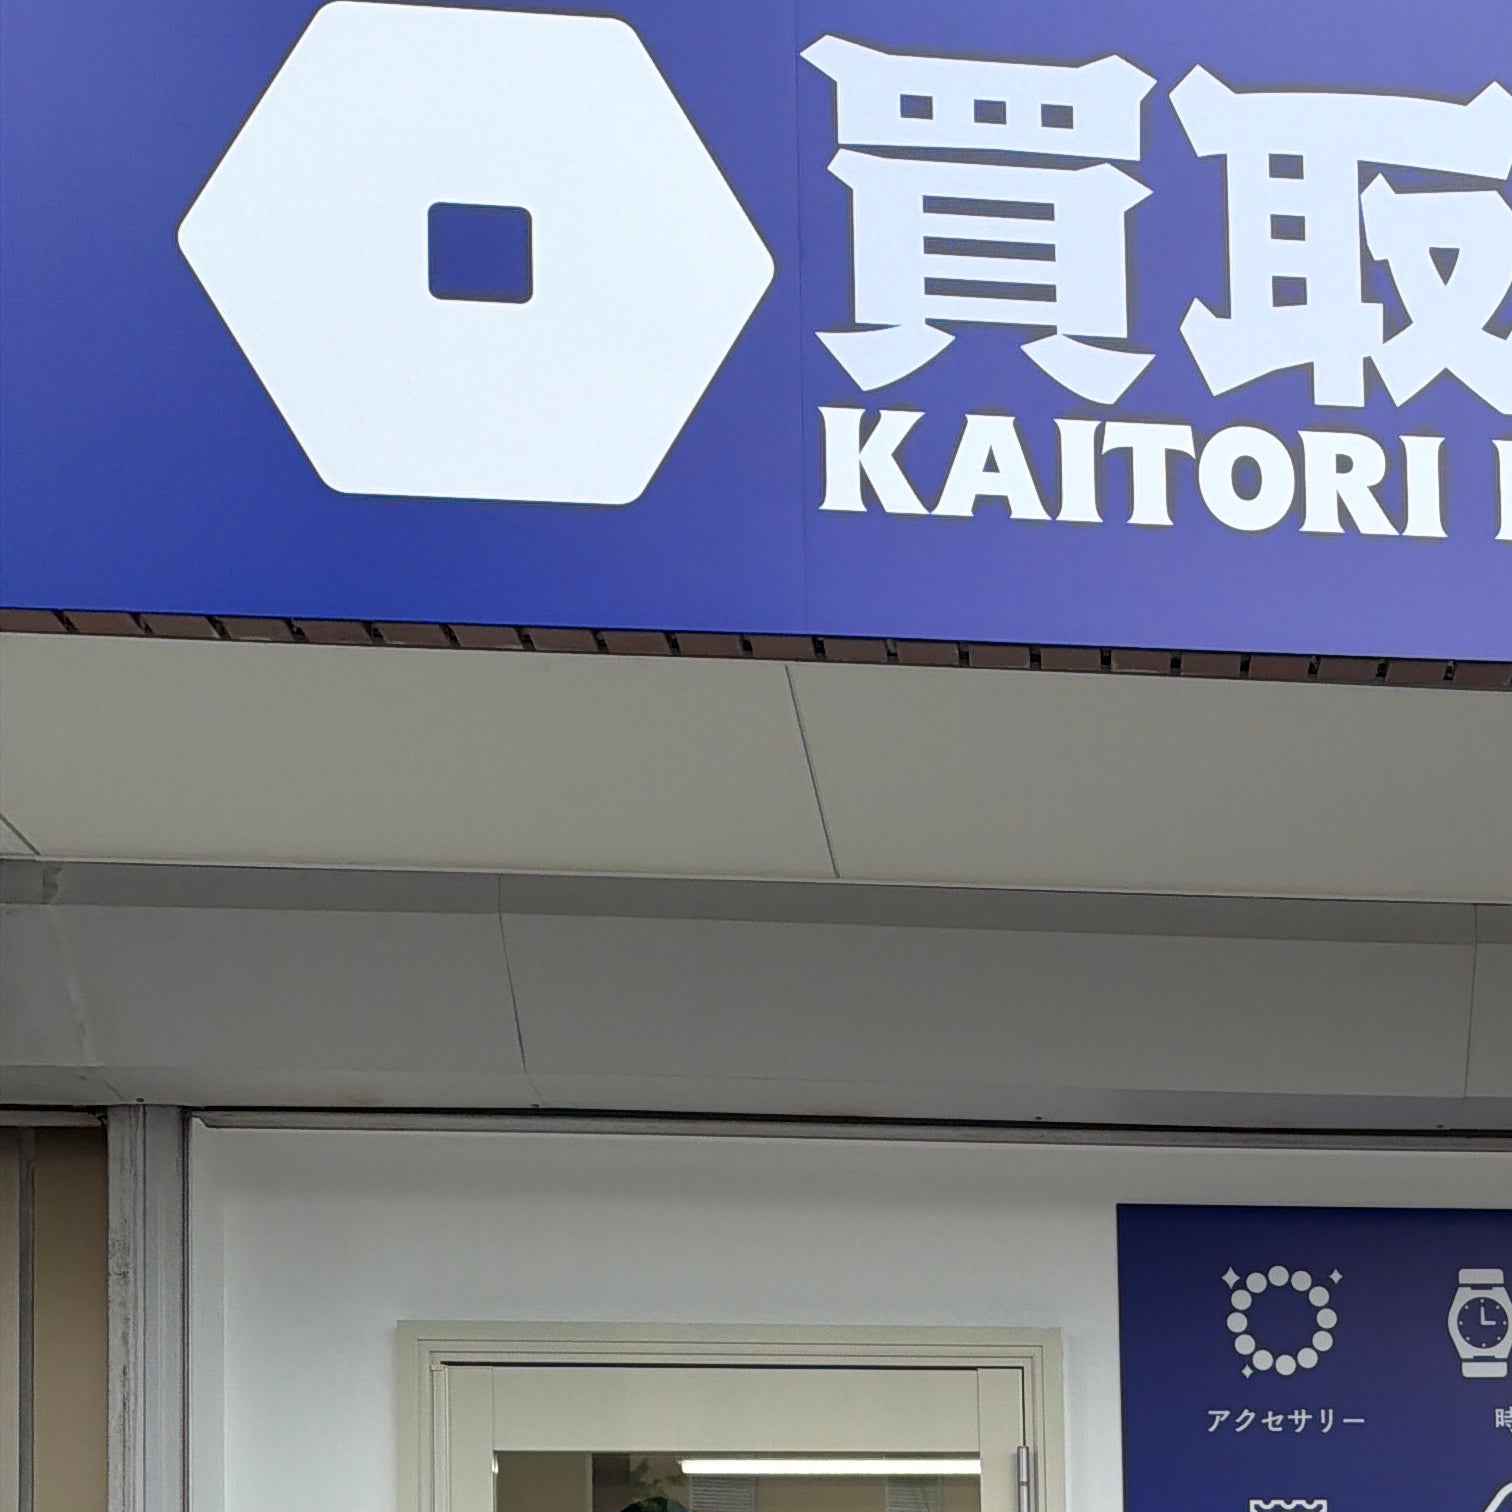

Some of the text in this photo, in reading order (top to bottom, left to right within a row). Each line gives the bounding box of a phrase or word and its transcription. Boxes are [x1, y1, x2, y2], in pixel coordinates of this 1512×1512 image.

[817, 405, 1449, 538] KAITORI
[1207, 1408, 1365, 1433] アクセサリー
